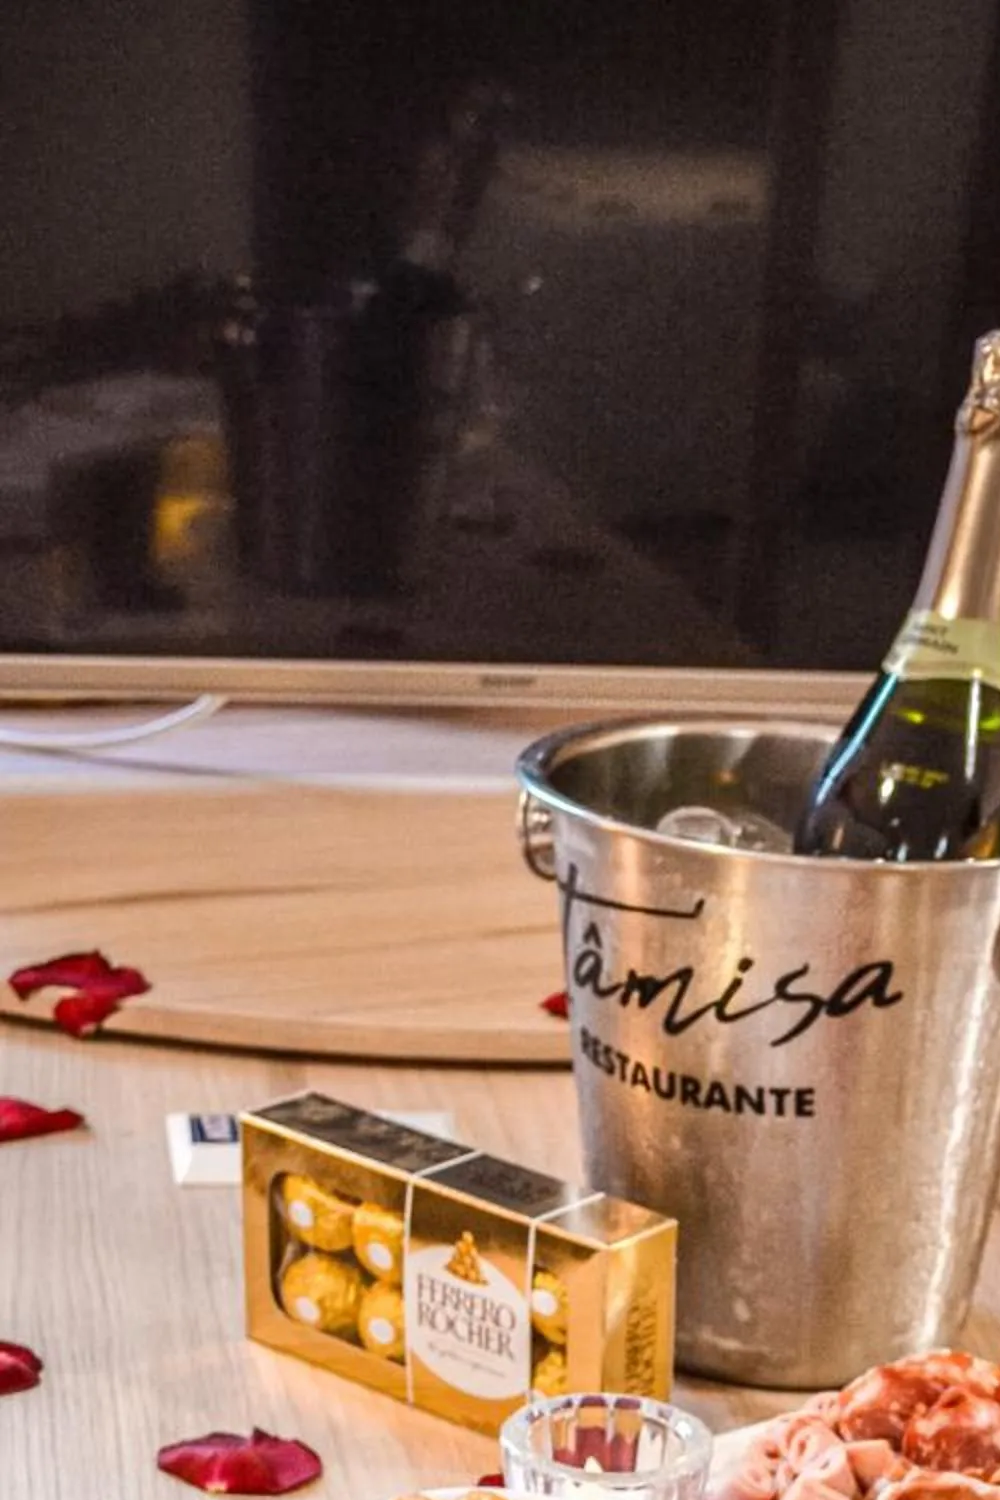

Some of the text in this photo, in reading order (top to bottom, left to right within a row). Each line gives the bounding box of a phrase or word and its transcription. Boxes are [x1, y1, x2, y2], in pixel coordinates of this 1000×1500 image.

[580, 1027, 816, 1118] RESTAURANTE
[417, 1273, 517, 1332] FERRERO
[417, 1301, 516, 1362] ROCHER
